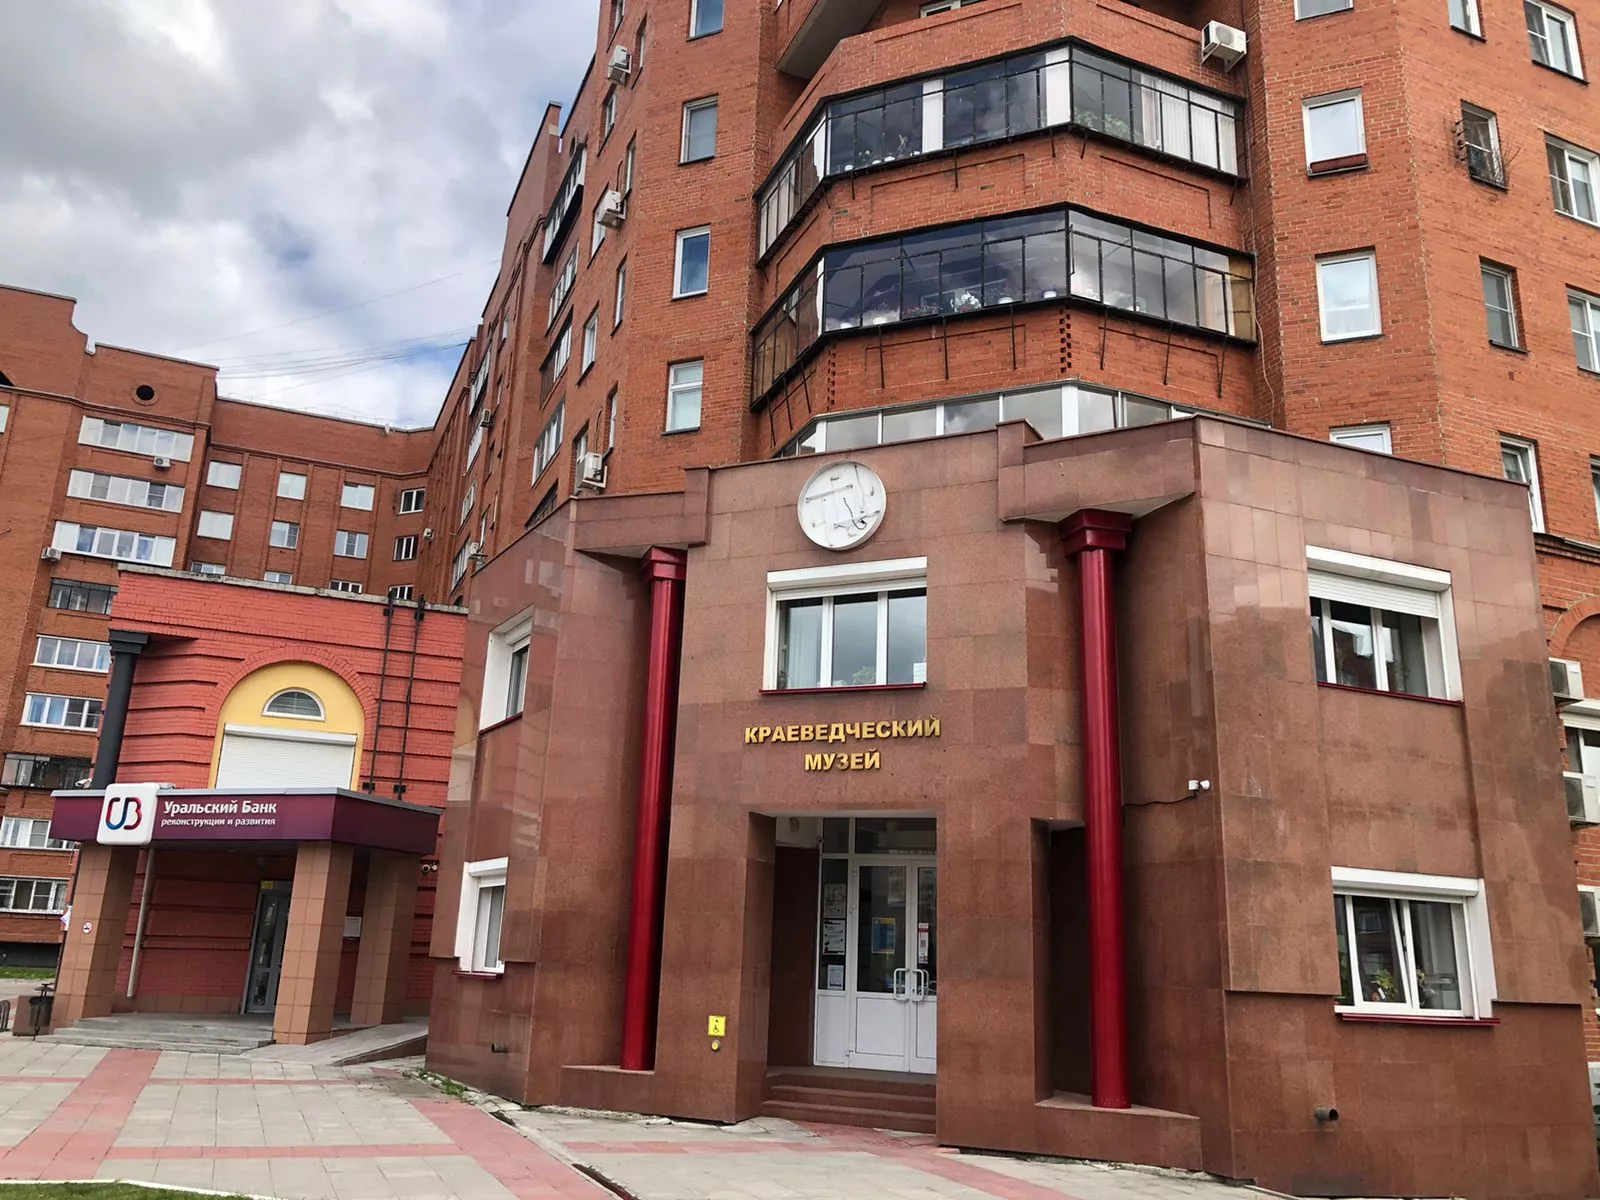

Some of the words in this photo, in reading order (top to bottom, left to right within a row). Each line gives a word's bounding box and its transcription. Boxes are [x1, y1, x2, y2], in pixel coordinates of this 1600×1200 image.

[744, 714, 941, 744] КРАЕВЕДЧЕСКИЙ
[804, 747, 881, 771] МУЗЕЙ
[163, 800, 238, 817] Уральский
[241, 800, 277, 814] Банк
[160, 818, 225, 828] реконструкции
[234, 818, 276, 828] развития
